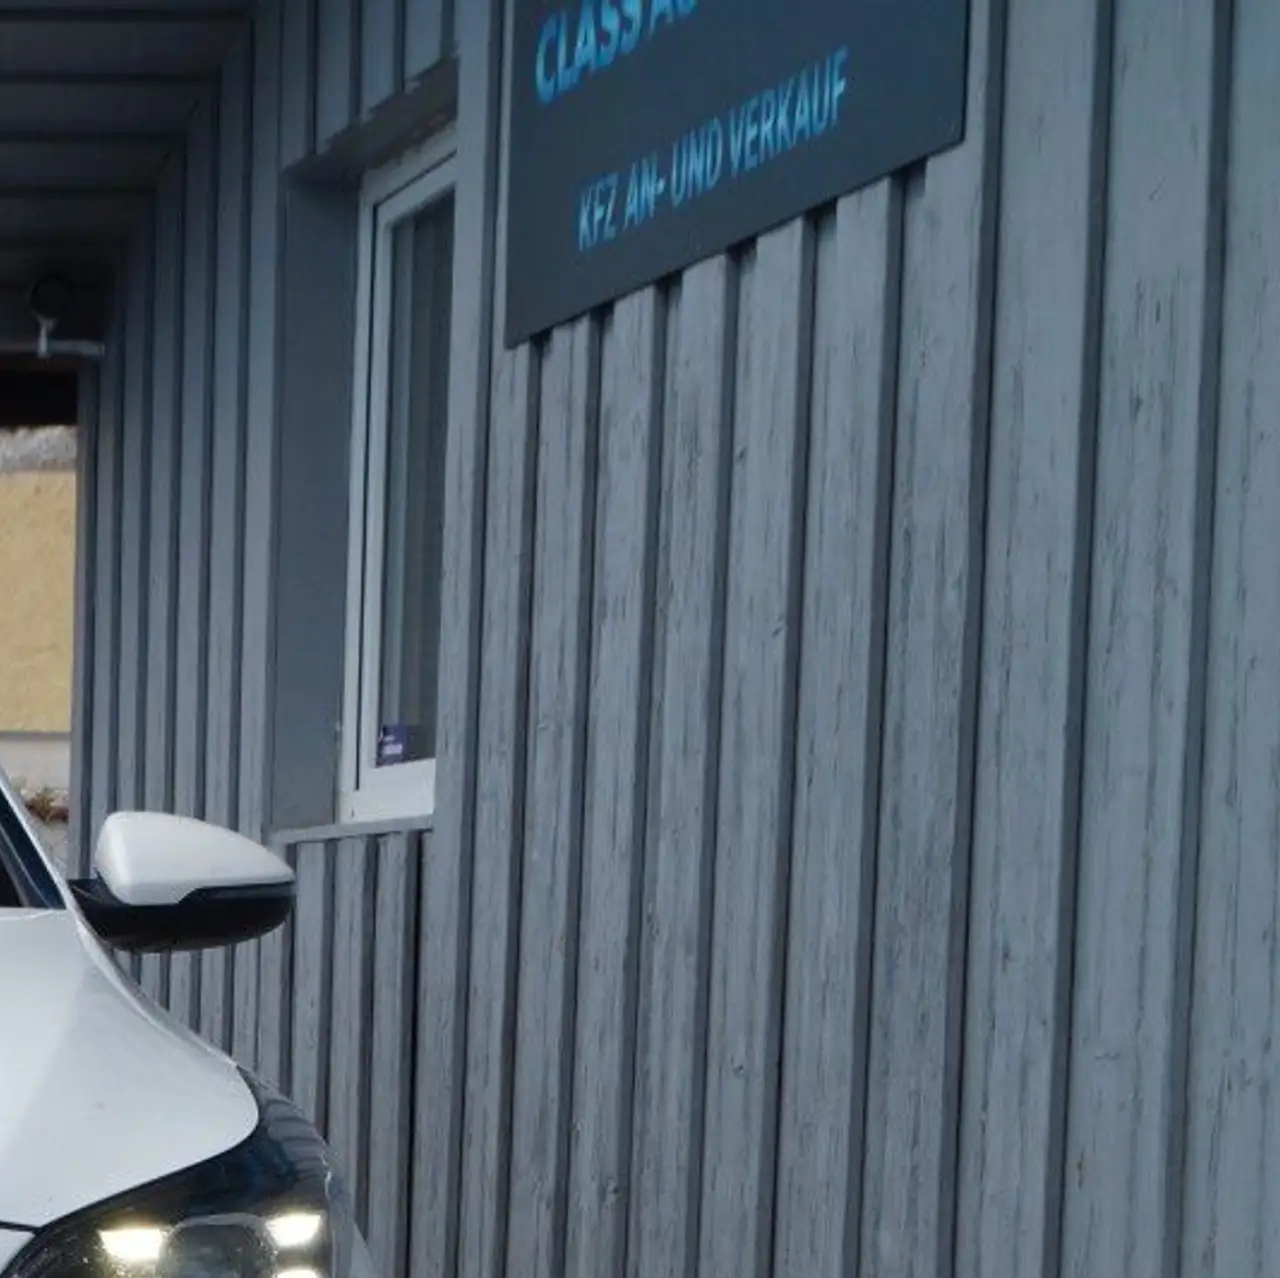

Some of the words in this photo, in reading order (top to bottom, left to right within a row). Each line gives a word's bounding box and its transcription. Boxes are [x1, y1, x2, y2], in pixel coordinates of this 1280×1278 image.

[578, 172, 619, 251] KFZ
[671, 115, 722, 208] UND
[729, 46, 848, 178] VERKAUF
